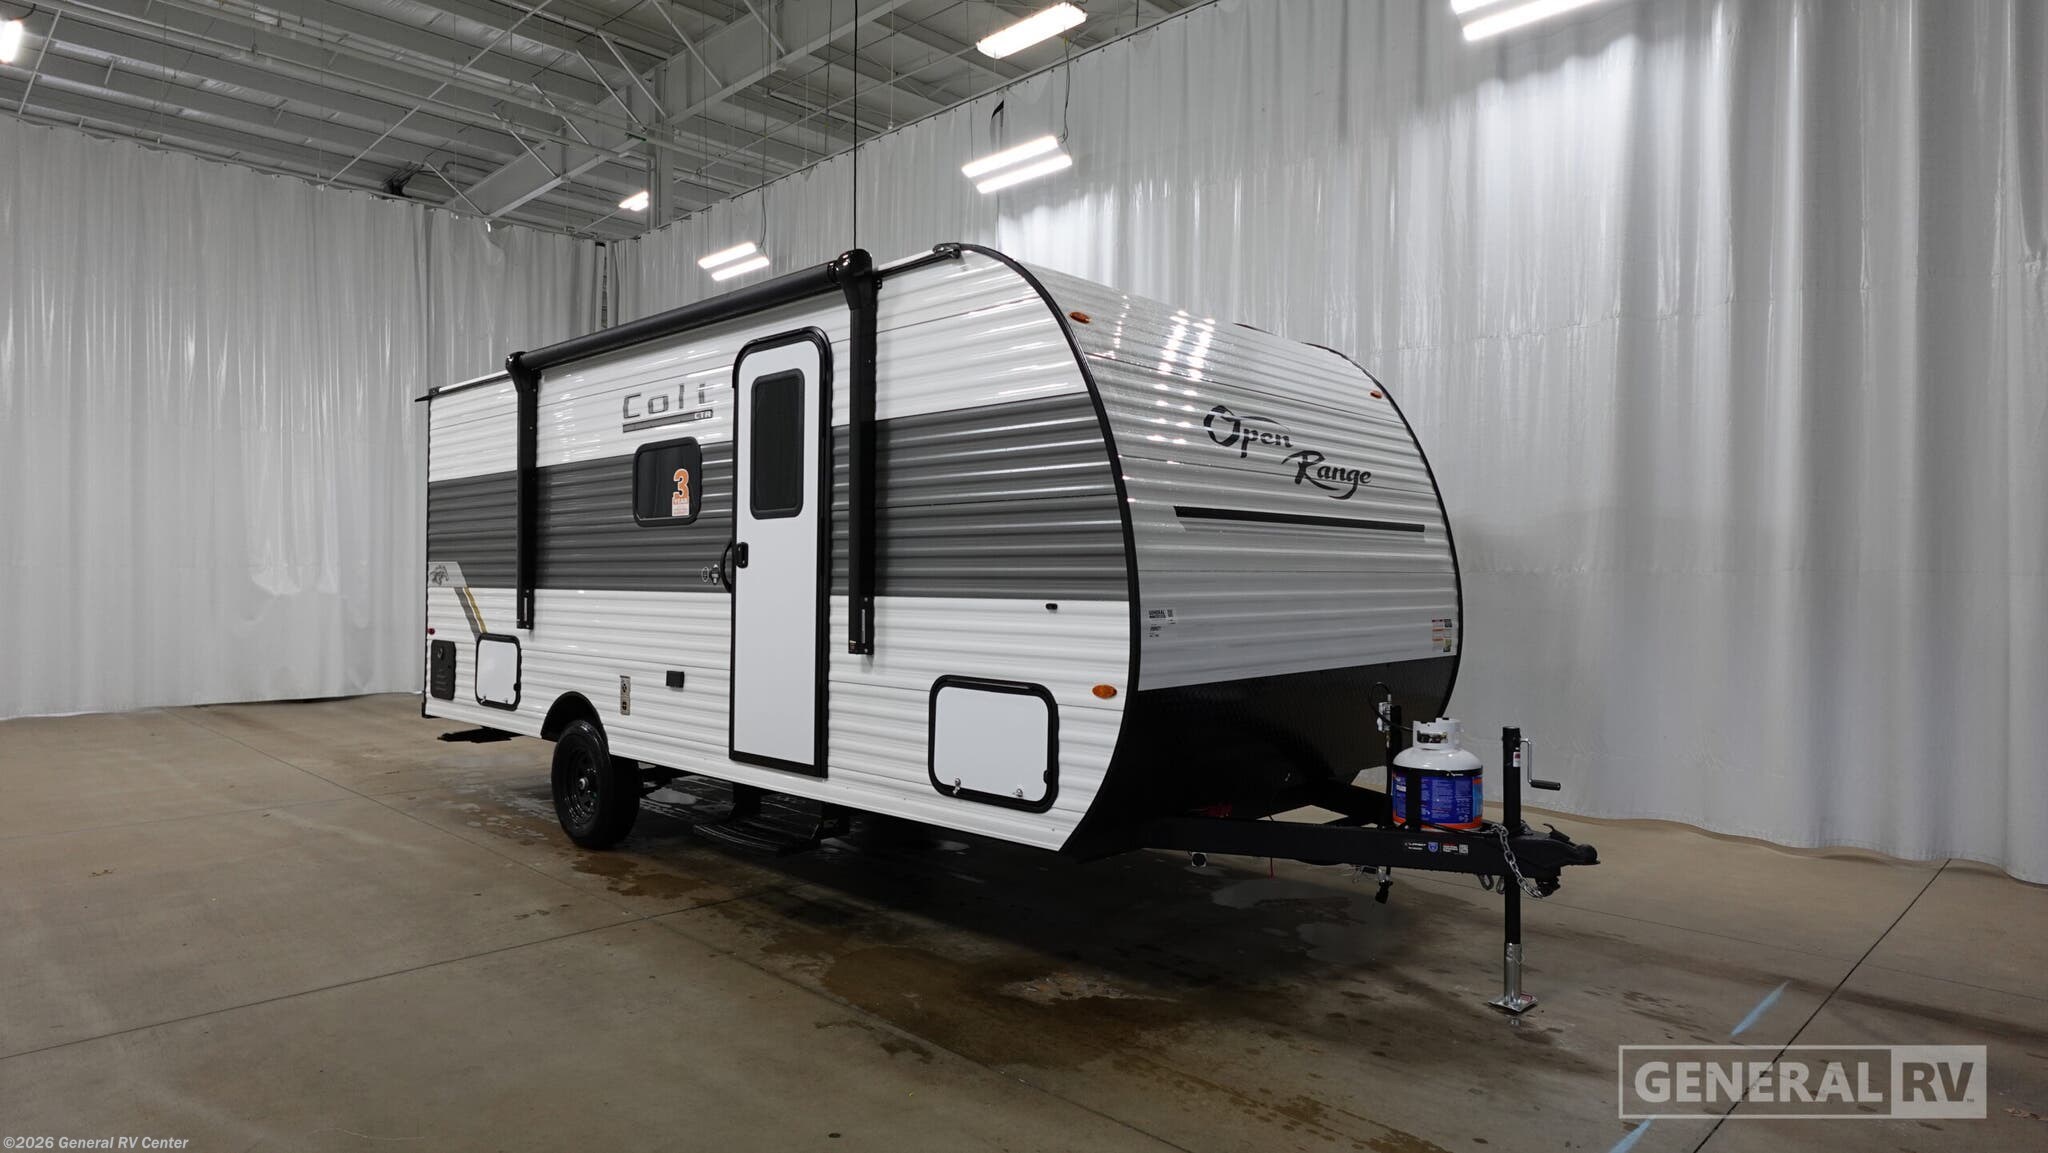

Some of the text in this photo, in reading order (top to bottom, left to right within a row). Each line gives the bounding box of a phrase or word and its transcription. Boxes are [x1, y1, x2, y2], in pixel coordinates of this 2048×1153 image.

[1203, 405, 1294, 458] Open
[672, 468, 690, 499] 3
[1281, 450, 1372, 500] Range
